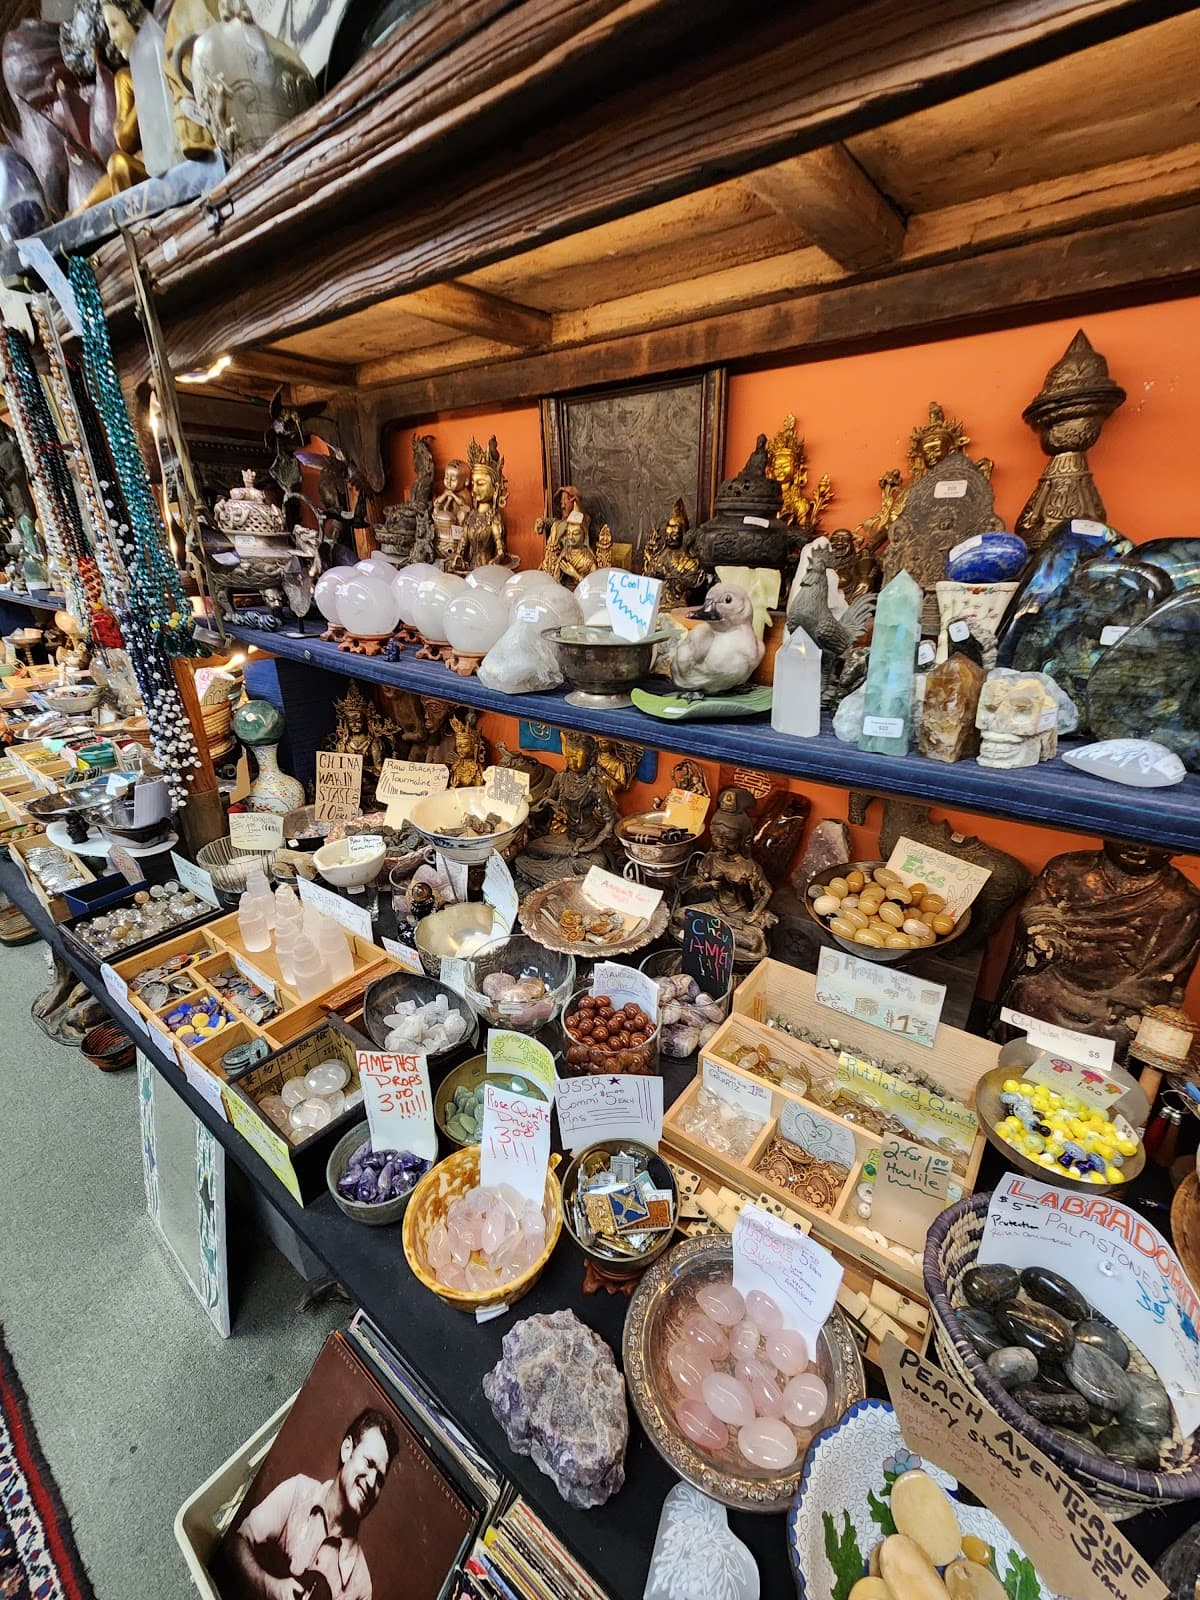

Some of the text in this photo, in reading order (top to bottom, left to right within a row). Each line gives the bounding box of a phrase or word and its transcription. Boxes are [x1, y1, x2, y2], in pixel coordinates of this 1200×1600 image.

[319, 753, 361, 771] CHINA
[900, 855, 945, 888] EGGS
[557, 1077, 606, 1094] USSR
[843, 1056, 920, 1102] Rutilated
[487, 1087, 509, 1111] Rose
[557, 1093, 600, 1111] Commi
[928, 1097, 978, 1127] Quartz
[883, 1141, 900, 1161] 2
[901, 1376, 959, 1428] worry
[900, 1349, 1151, 1589] PEACH AVENTURINE
